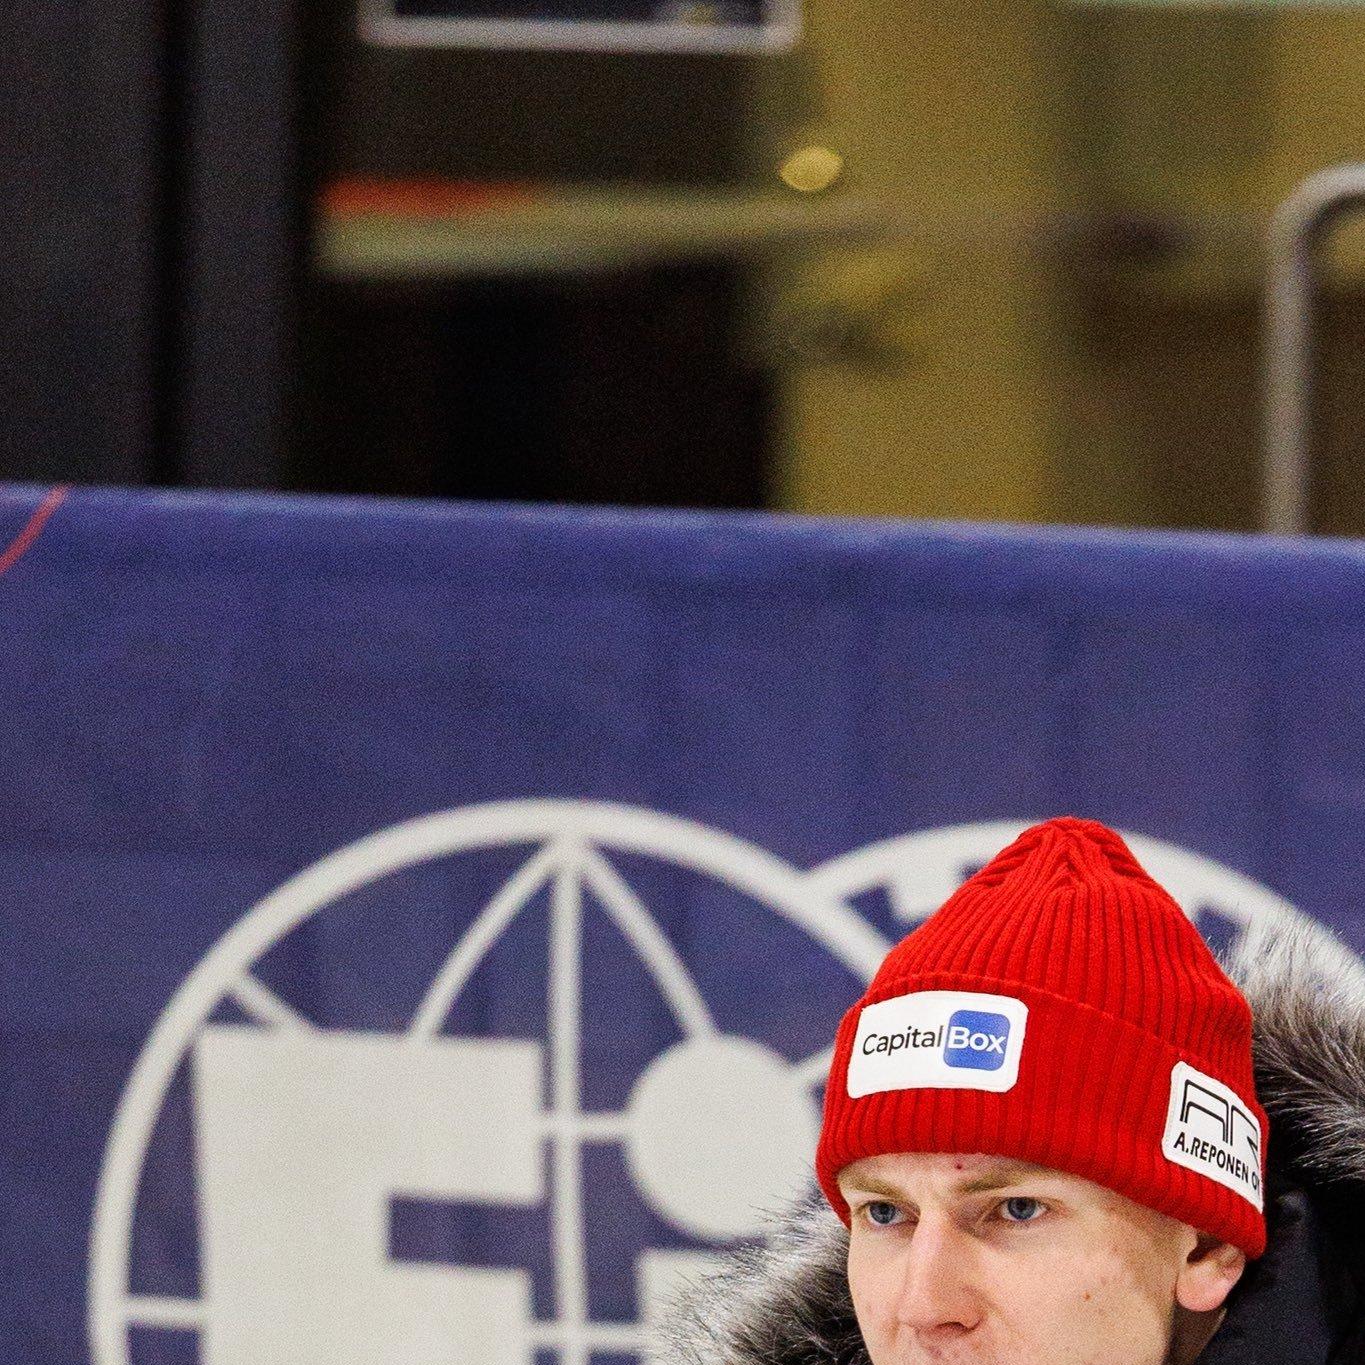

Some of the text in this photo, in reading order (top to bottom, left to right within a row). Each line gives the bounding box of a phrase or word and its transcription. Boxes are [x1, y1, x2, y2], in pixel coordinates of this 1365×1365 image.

[863, 1025, 1006, 1056] Capital Box
[1173, 1132, 1249, 1183] A.REPONEN
